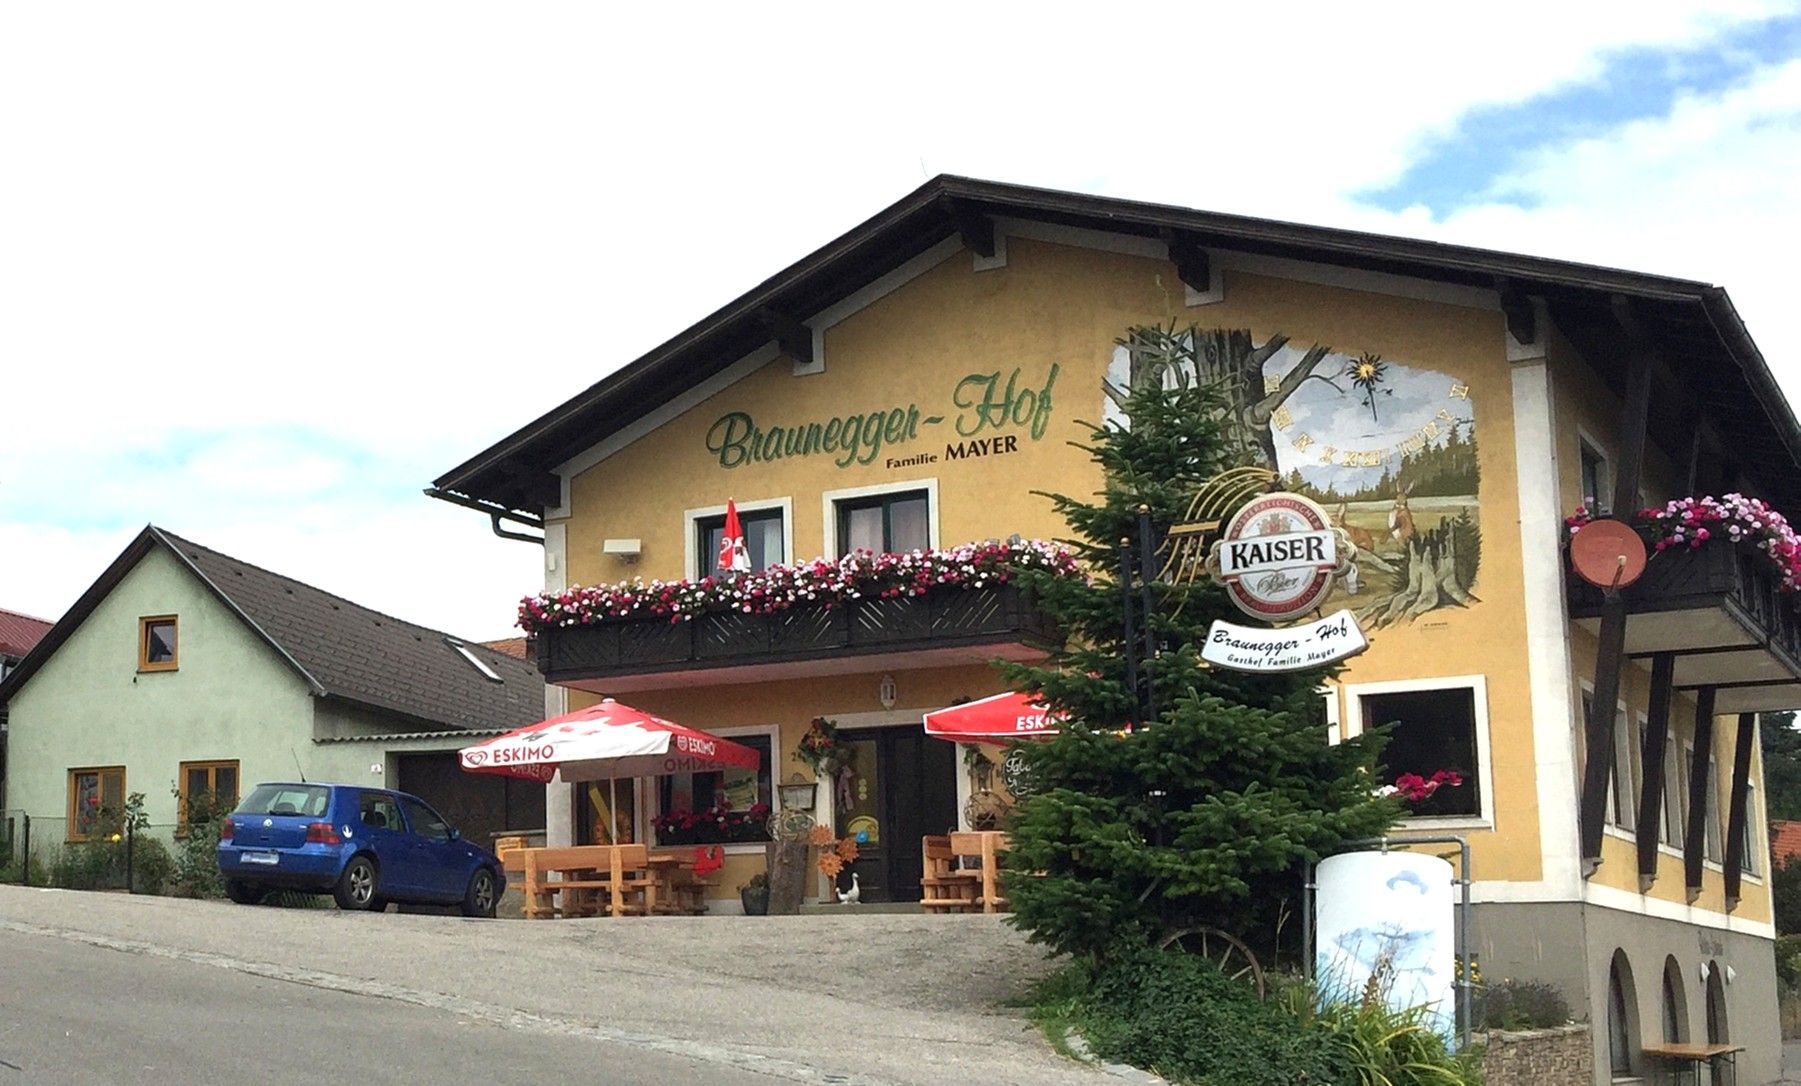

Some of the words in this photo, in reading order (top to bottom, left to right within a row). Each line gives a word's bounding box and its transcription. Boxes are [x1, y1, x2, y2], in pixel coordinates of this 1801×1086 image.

[952, 362, 1061, 441] Hof
[885, 451, 938, 470] Familie
[944, 434, 1018, 461] MAYER
[1230, 536, 1326, 570] KAISER
[1213, 629, 1299, 656] Braunegger
[1316, 617, 1348, 640] Hof
[1267, 655, 1302, 666] Familie
[1307, 647, 1336, 660] Mayer
[493, 744, 554, 763] ESKIMO
